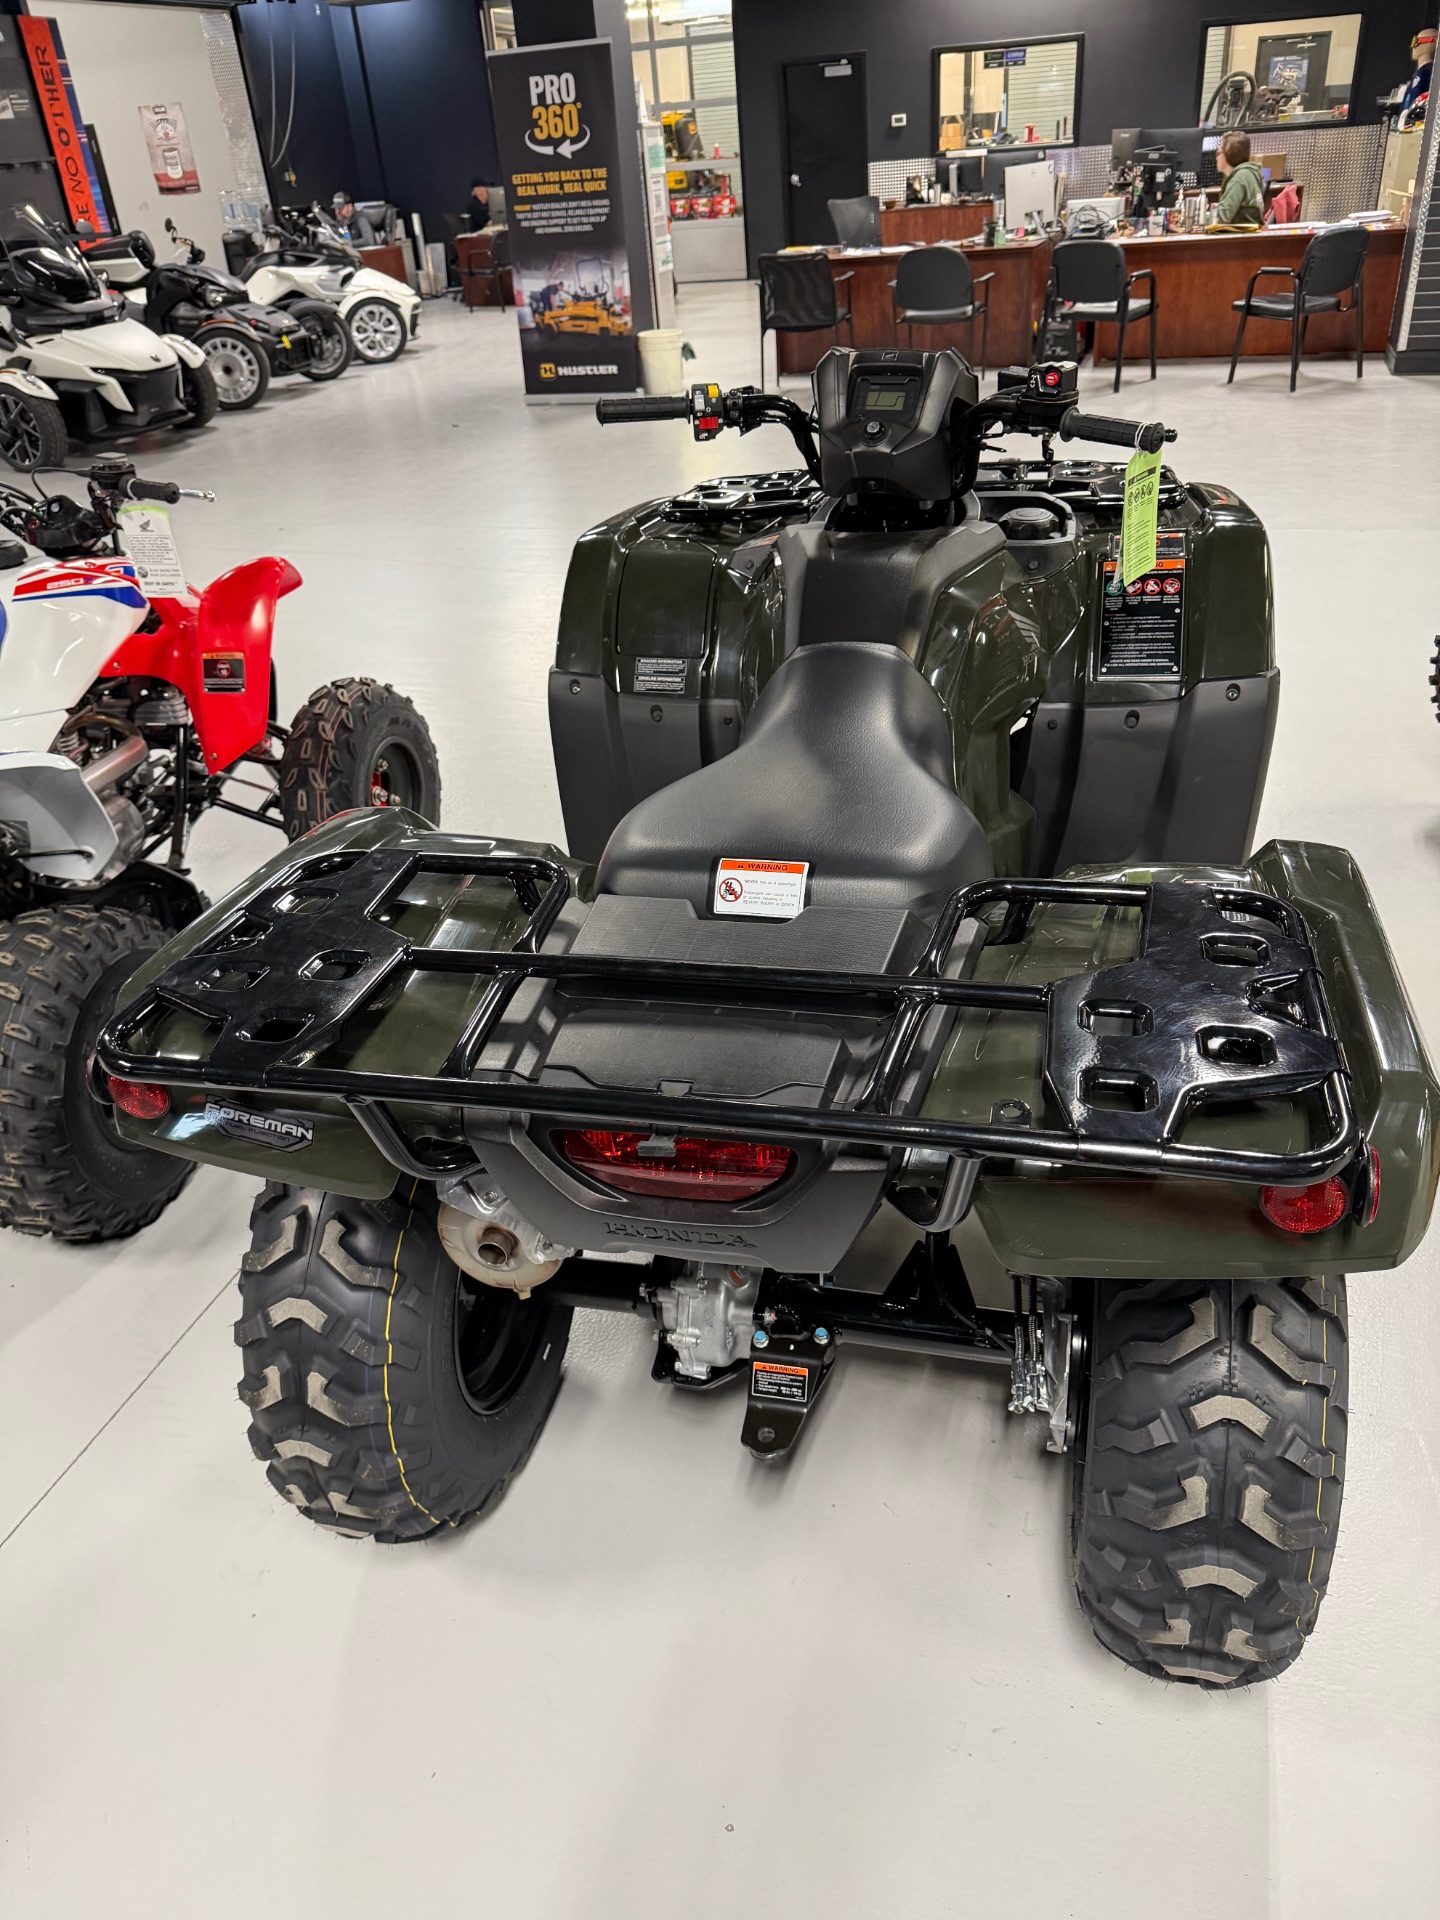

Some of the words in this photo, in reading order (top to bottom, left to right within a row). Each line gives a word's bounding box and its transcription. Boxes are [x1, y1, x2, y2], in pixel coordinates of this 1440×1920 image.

[35, 45, 71, 147] OTHER
[529, 72, 576, 106] PRO
[65, 156, 85, 194] NO
[512, 173, 544, 185] GETTING
[544, 171, 560, 182] YOU
[560, 170, 581, 181] BACK
[581, 169, 592, 179] TO
[592, 168, 608, 178] THE
[516, 185, 536, 197] REAL
[563, 182, 583, 193] REAL
[583, 180, 607, 193] QUICK
[557, 365, 618, 376] HUSTLER
[748, 863, 788, 871] WARNING
[204, 1102, 313, 1140] FOREMAN
[603, 1222, 758, 1247] HONDA
[768, 1365, 799, 1373] WARNING
